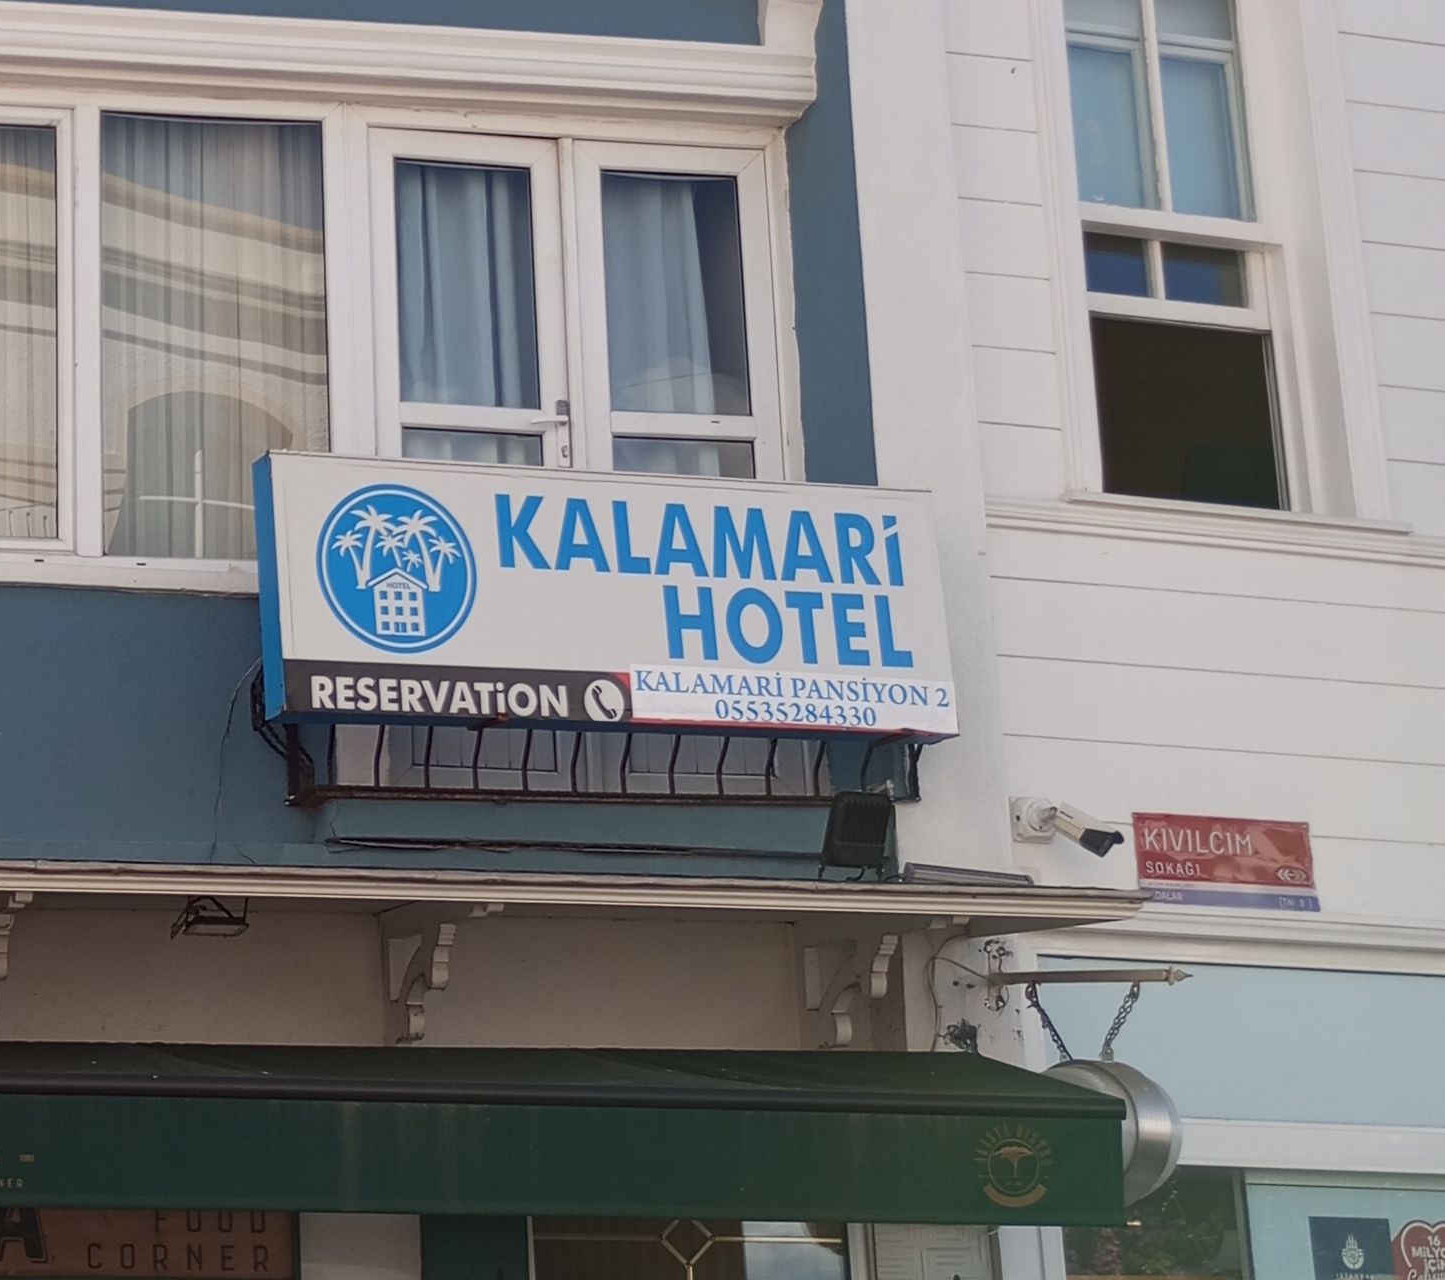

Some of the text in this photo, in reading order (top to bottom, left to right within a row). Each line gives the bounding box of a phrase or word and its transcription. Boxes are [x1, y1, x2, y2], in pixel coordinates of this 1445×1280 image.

[662, 584, 914, 669] HOTEL
[790, 675, 928, 709] PANSİYON
[929, 687, 951, 708] 2
[714, 698, 878, 727] 05535284330
[1144, 827, 1253, 856] KIVILCIM
[1145, 859, 1201, 877] SOKAĞI
[1154, 890, 1184, 903] DALAR
[1427, 1235, 1441, 1247] 16
[85, 1242, 270, 1272] CORNER
